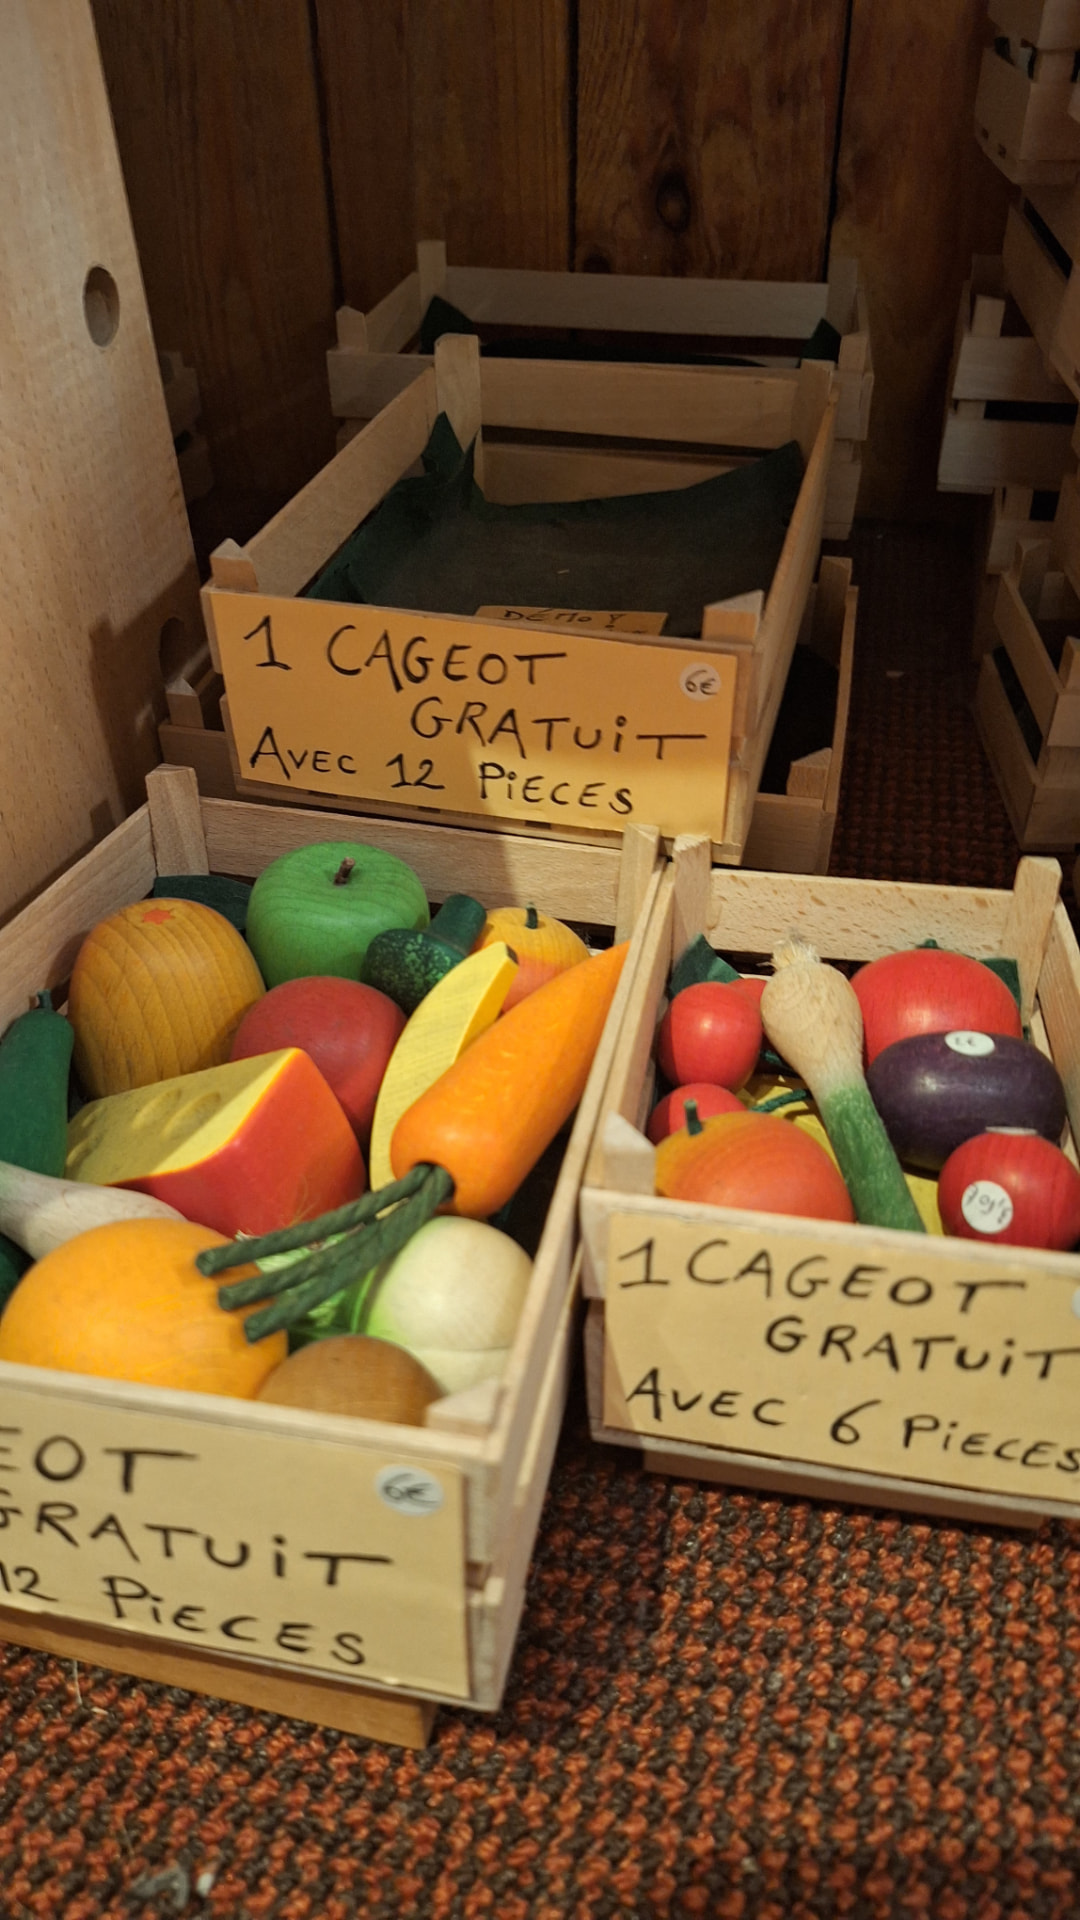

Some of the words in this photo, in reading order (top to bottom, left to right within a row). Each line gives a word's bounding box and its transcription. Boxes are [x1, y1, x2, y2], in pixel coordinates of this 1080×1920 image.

[243, 615, 292, 671] 1
[326, 624, 568, 693] CAGEOT
[684, 668, 718, 696] 6€
[249, 726, 358, 780] AVEC
[385, 752, 446, 791] 12
[618, 1237, 671, 1289] 1
[685, 1237, 1027, 1314] CAGEOT
[625, 1367, 787, 1426] AVEC
[828, 1398, 882, 1446] 6
